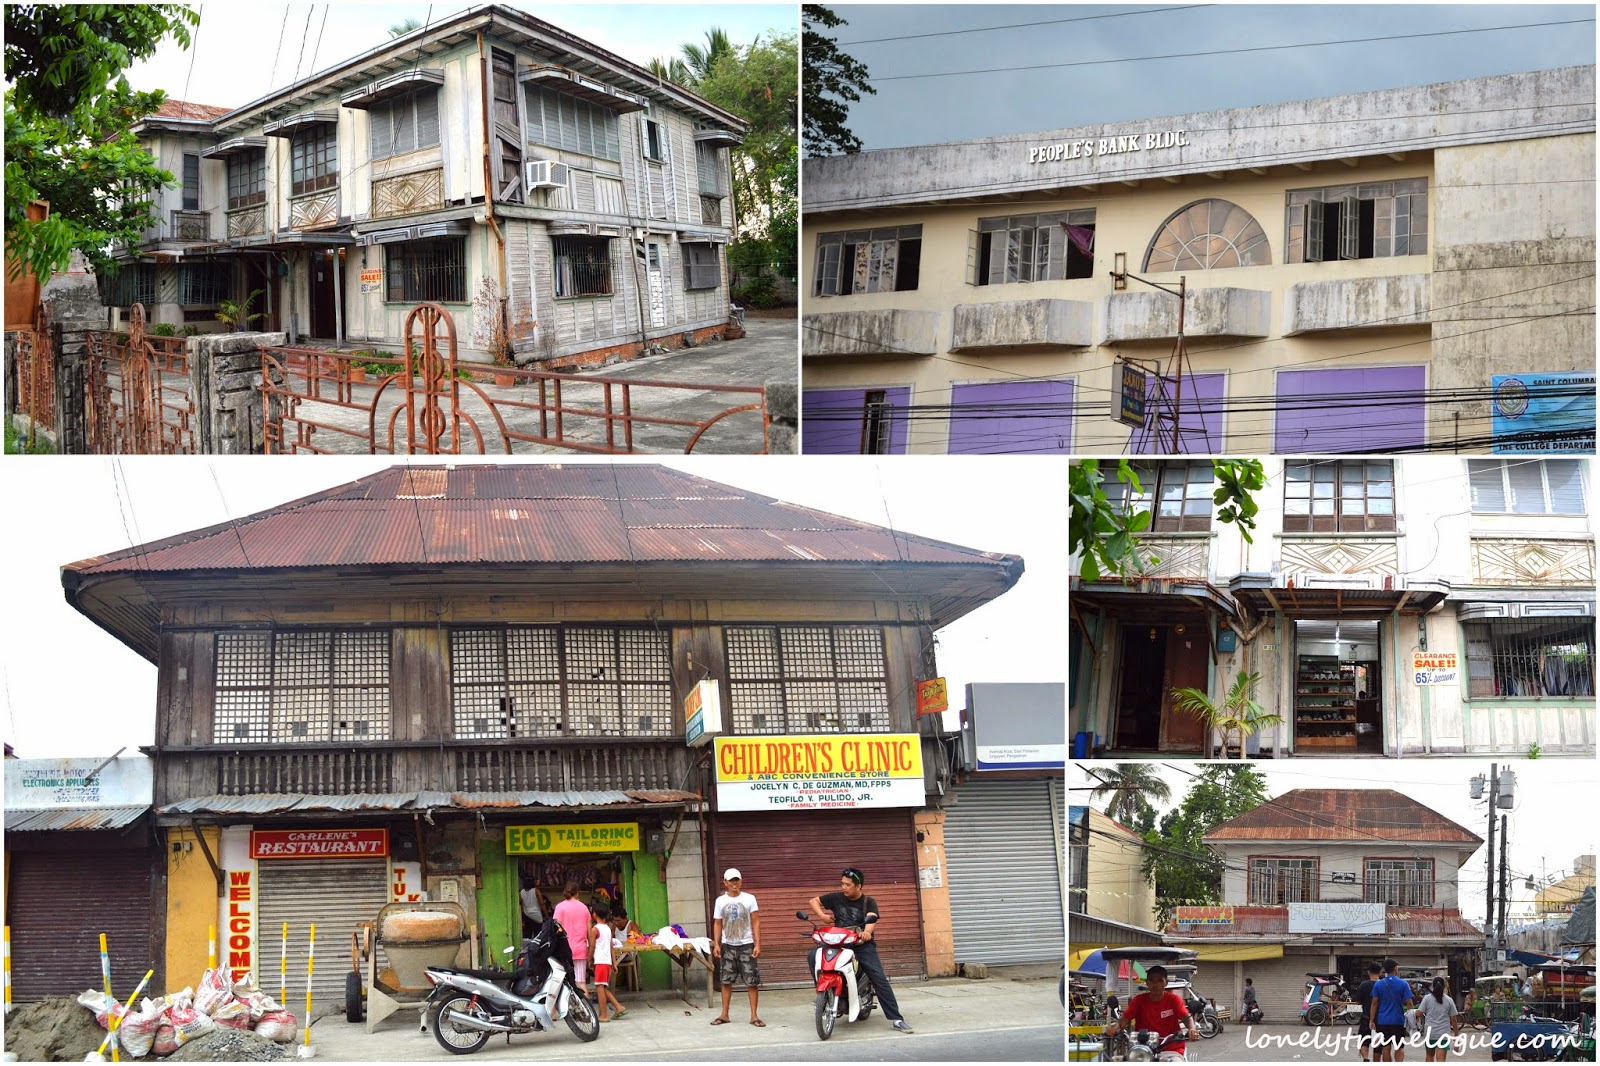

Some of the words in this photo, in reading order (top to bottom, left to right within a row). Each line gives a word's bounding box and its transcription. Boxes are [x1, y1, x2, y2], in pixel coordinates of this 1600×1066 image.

[1029, 140, 1094, 164] PEOPLE'S
[1098, 135, 1140, 156] BANK
[1145, 130, 1190, 151] BLDG.
[1558, 377, 1596, 385] COLUMBA
[1414, 660, 1456, 668] SALE!!
[1416, 672, 1432, 684] 65%
[721, 742, 832, 774] CHILDREN'S
[841, 741, 912, 772] CLINIC
[782, 772, 856, 780] CONVENIENCE
[23, 778, 65, 788] ELECTRONICS
[751, 783, 788, 791] JOCELYN
[816, 781, 853, 789] GUZMAN,
[870, 780, 891, 788] FPPS
[769, 795, 804, 804] TEOFILO
[858, 793, 873, 801] JR.
[288, 831, 357, 841] CARLENE'S
[509, 828, 552, 851] ECD
[556, 828, 634, 840] TAILORING
[258, 841, 381, 854] RESTAURANT
[1179, 907, 1232, 919] SUSAN'S
[1291, 904, 1336, 921] FULL
[1341, 904, 1384, 921] WIN
